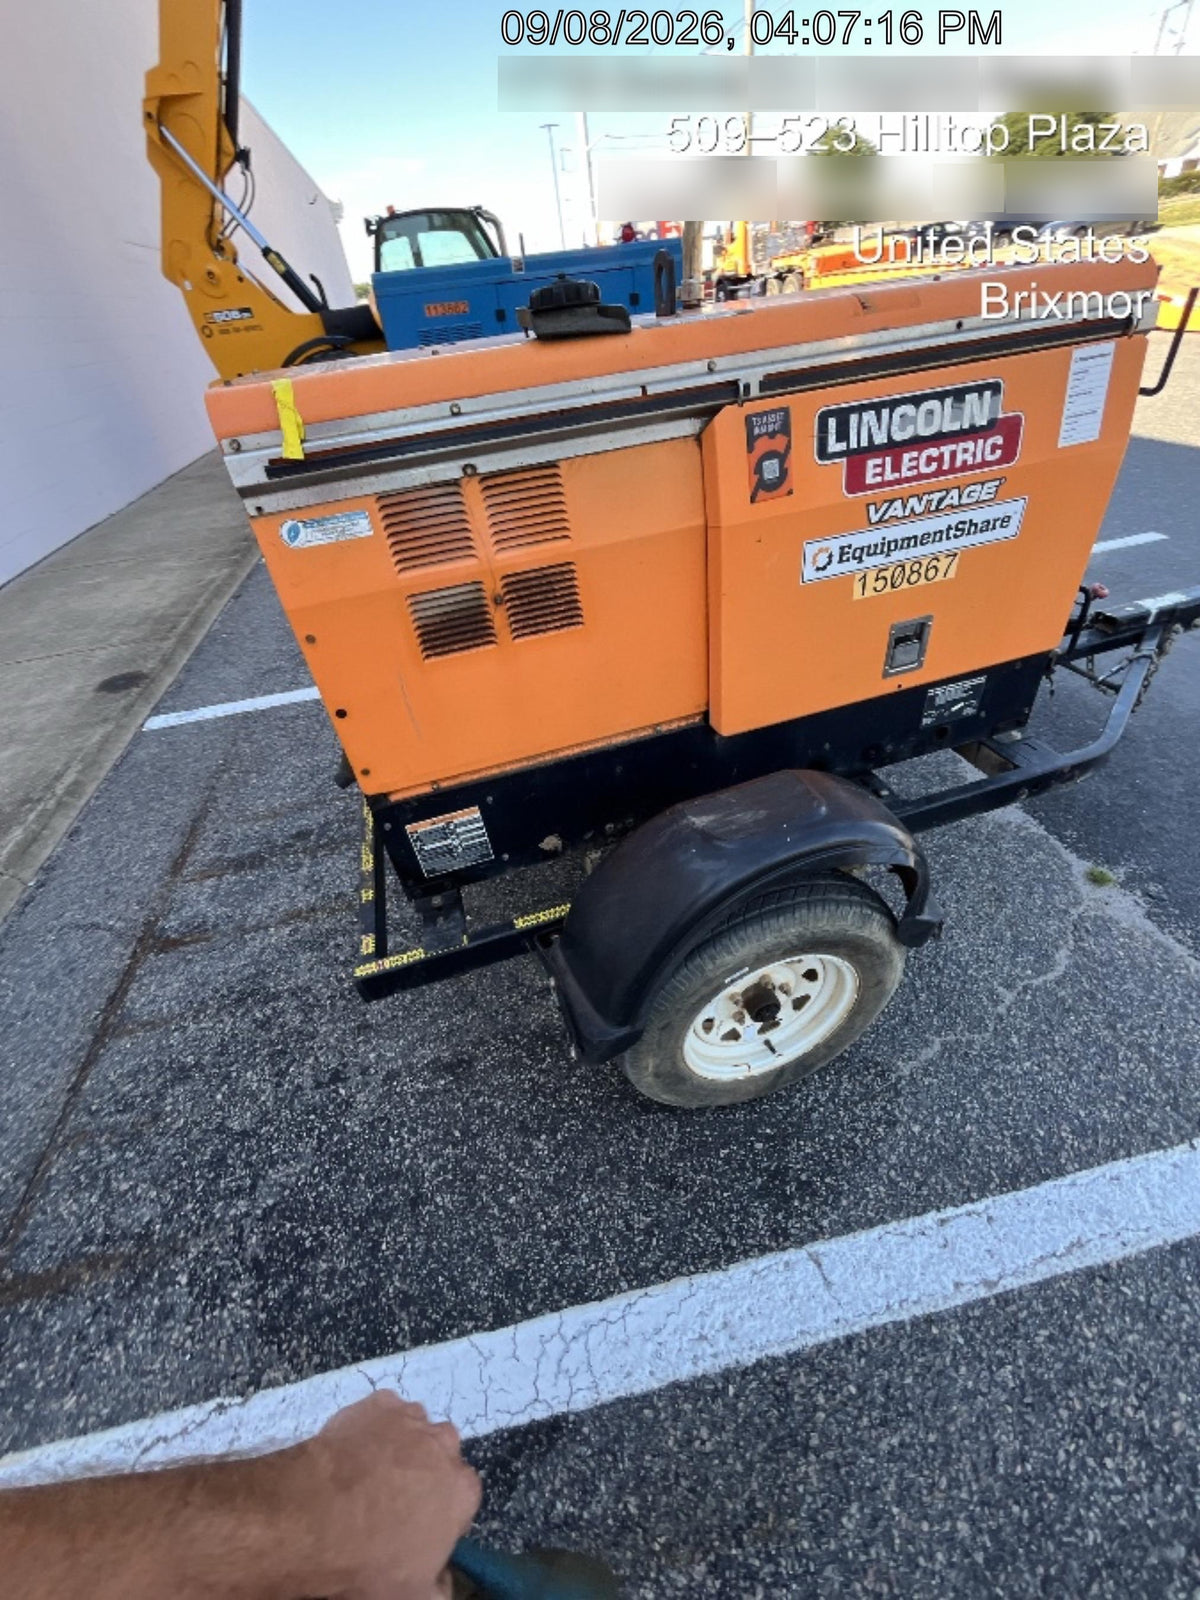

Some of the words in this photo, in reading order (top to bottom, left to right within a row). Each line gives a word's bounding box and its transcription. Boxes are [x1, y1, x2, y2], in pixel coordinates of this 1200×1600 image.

[827, 390, 991, 453] LINCOLN
[865, 434, 1004, 485] ELECTRIC
[866, 477, 1000, 525] VANTAGE
[837, 513, 1011, 564] EquipmentShare
[858, 552, 958, 596] 150867
